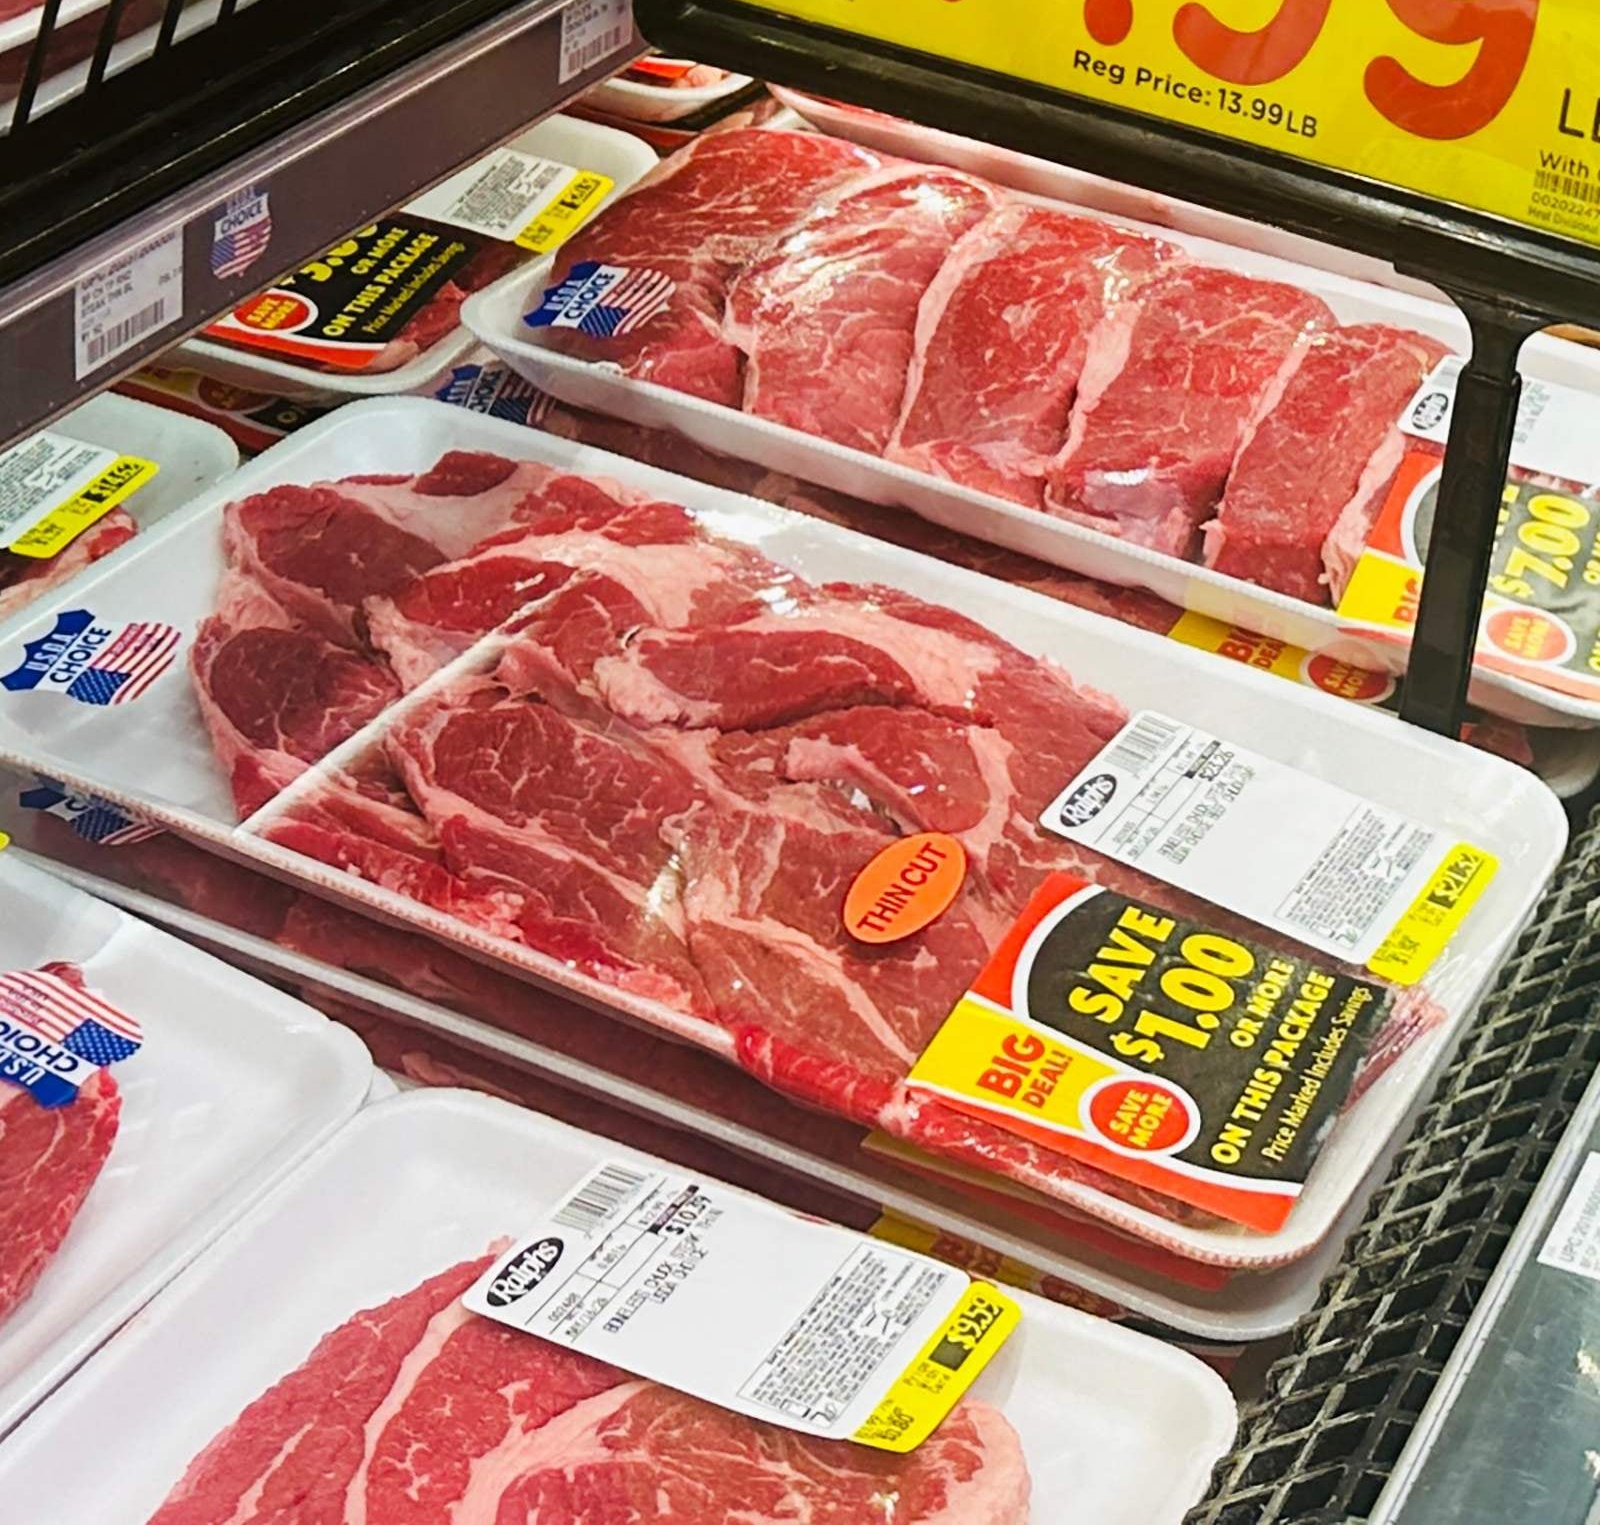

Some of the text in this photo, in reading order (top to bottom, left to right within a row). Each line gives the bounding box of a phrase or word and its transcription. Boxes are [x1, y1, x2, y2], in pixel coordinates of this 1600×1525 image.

[1072, 47, 1127, 85] Reg
[1538, 148, 1590, 180] With
[220, 203, 263, 235] CHOICE
[350, 226, 409, 276] OR MORE
[246, 297, 281, 325] SAVE
[260, 299, 299, 331] MORE
[322, 312, 357, 337] ON
[343, 283, 387, 314] THIS
[373, 232, 440, 286] PACKAGE
[562, 271, 617, 320] CHOICE
[1487, 493, 1592, 600] $7.00
[49, 626, 113, 685] CHOICE
[1061, 776, 1116, 826] Ralphs
[856, 841, 948, 935] THIN CUT
[1068, 905, 1177, 1025] SAVE
[1109, 933, 1256, 1065] $1.00
[1228, 958, 1296, 1049] OR MORE
[976, 1031, 1047, 1100] BIG
[1020, 1039, 1075, 1110] DEAL!
[1209, 969, 1336, 1166] ON THIS PACKAGE
[1261, 985, 1374, 1163] Price Marked Includes Savings
[1108, 1088, 1148, 1135] SAVE
[1127, 1091, 1175, 1149] MORE
[491, 1241, 560, 1304] Ralphs
